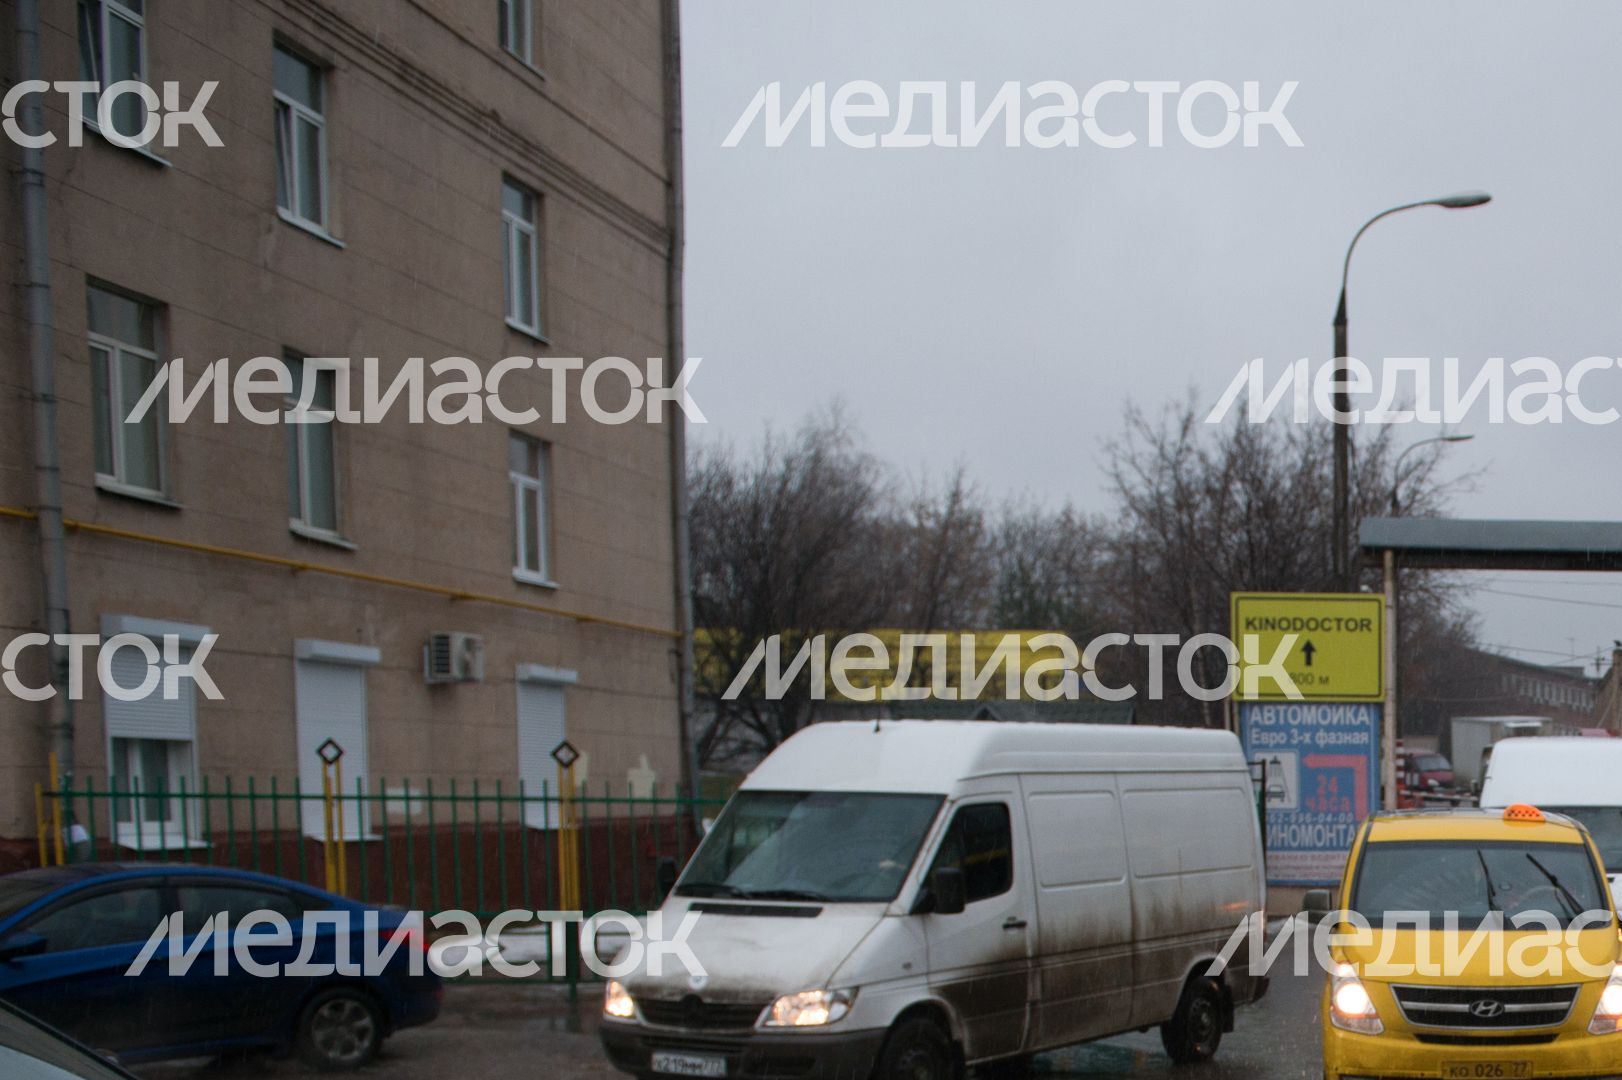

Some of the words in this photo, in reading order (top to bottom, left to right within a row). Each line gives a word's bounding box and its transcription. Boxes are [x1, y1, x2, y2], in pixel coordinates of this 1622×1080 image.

[1245, 616, 1372, 632] KINODOCTOR
[1315, 728, 1369, 748] фазная
[1475, 1063, 1504, 1078] 026
